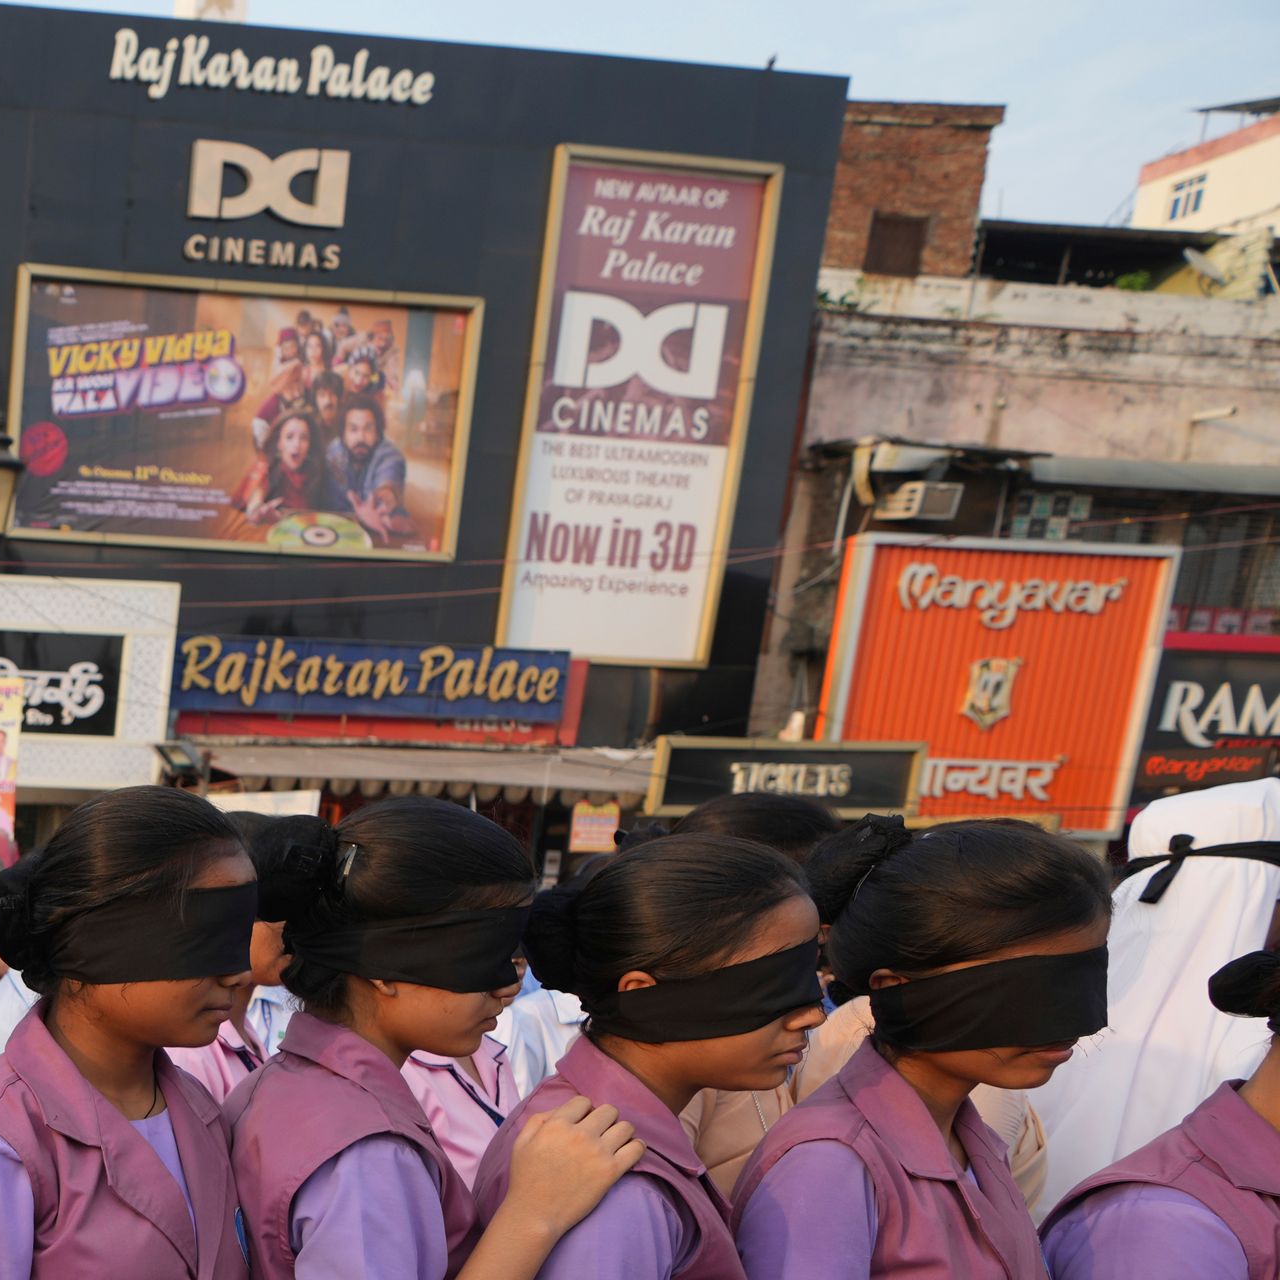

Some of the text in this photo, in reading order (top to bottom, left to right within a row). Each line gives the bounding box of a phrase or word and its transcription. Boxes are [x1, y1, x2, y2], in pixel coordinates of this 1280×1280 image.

[307, 44, 436, 105] Palace
[594, 178, 730, 210] NEW AVTAAR OF
[578, 204, 737, 249] Raj Karan
[183, 233, 341, 271] CINEMAS
[599, 248, 704, 287] Palace
[47, 337, 140, 378] VICKY
[551, 396, 710, 441] CINEMAS
[541, 439, 710, 469] THE BEST ULTRAMODERN
[550, 465, 692, 491] LUXURIOUS THEATRE
[564, 488, 673, 512] OF PRAYAGRAJ
[525, 511, 698, 573] Now in 3D
[521, 569, 690, 598] Amazing Experience
[898, 562, 1128, 630] Manyavar
[179, 635, 560, 707] Rajkaran Palace
[730, 762, 853, 796] TICKETS
